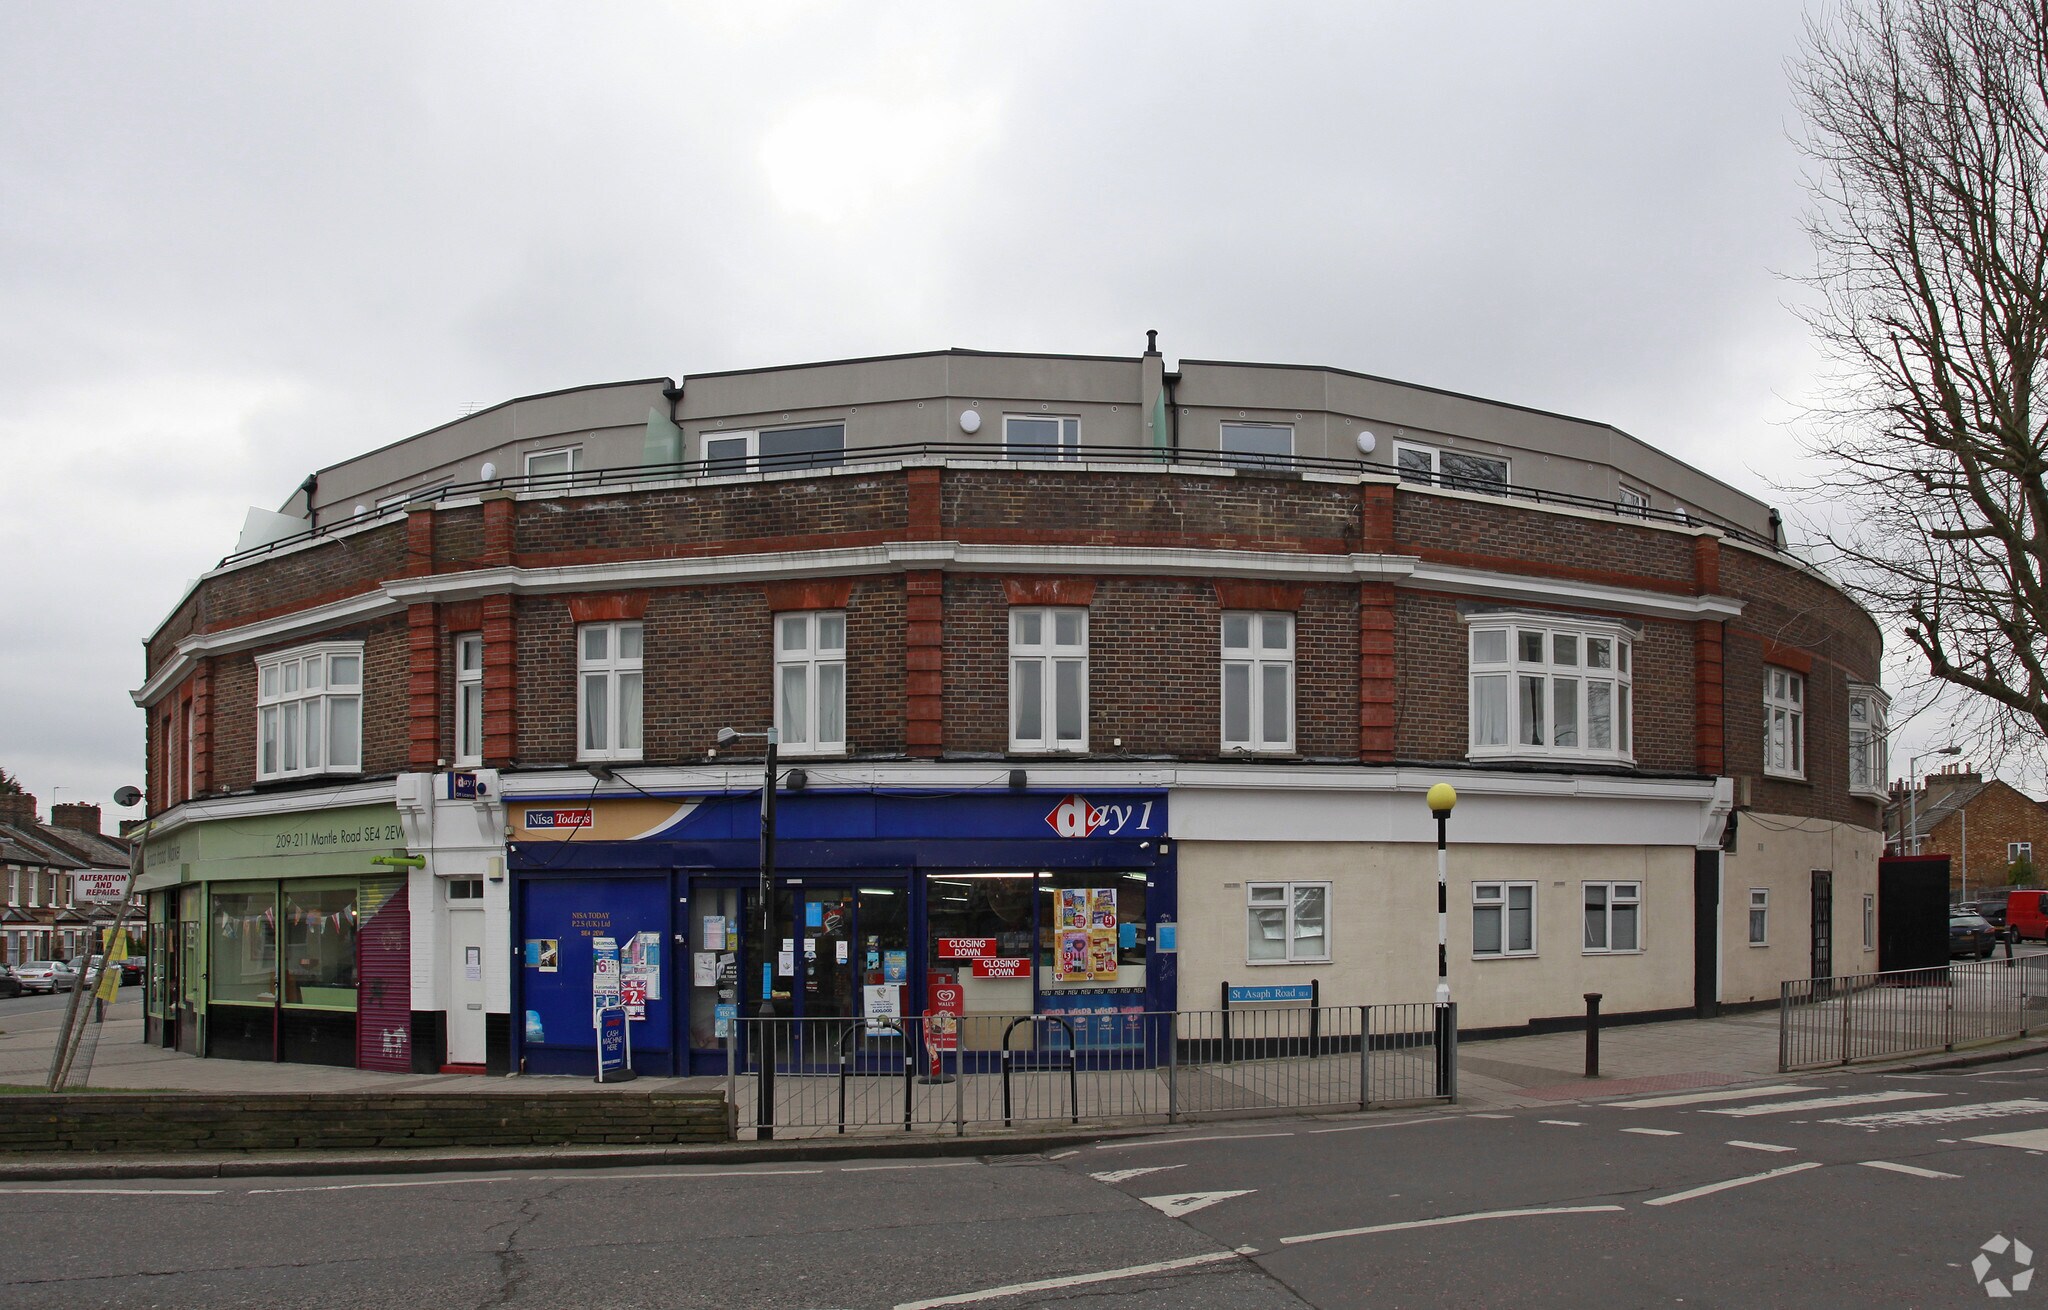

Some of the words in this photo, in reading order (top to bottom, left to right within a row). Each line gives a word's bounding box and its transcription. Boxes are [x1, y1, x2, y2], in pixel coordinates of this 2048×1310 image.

[556, 812, 590, 826] Today's
[1056, 794, 1132, 838] day
[1136, 801, 1153, 830] 1
[276, 833, 309, 849] 209-211
[311, 829, 338, 846] Mantle
[341, 826, 361, 843] Road
[364, 826, 380, 842] SE4
[385, 824, 405, 841] 2EW
[79, 874, 127, 882] ALTERATION
[94, 881, 112, 889] AND
[572, 911, 587, 919] NISA
[589, 911, 610, 919] TODAY
[949, 939, 986, 949] CLOSING
[954, 948, 981, 957] DOWN
[983, 959, 1020, 969] CLOSING
[988, 968, 1015, 977] DOWN
[1232, 989, 1241, 998] St
[1245, 989, 1271, 1000] Asaph
[1275, 988, 1296, 998] Road
[602, 1036, 622, 1045] MACHINE
[606, 1043, 617, 1051] HERE
